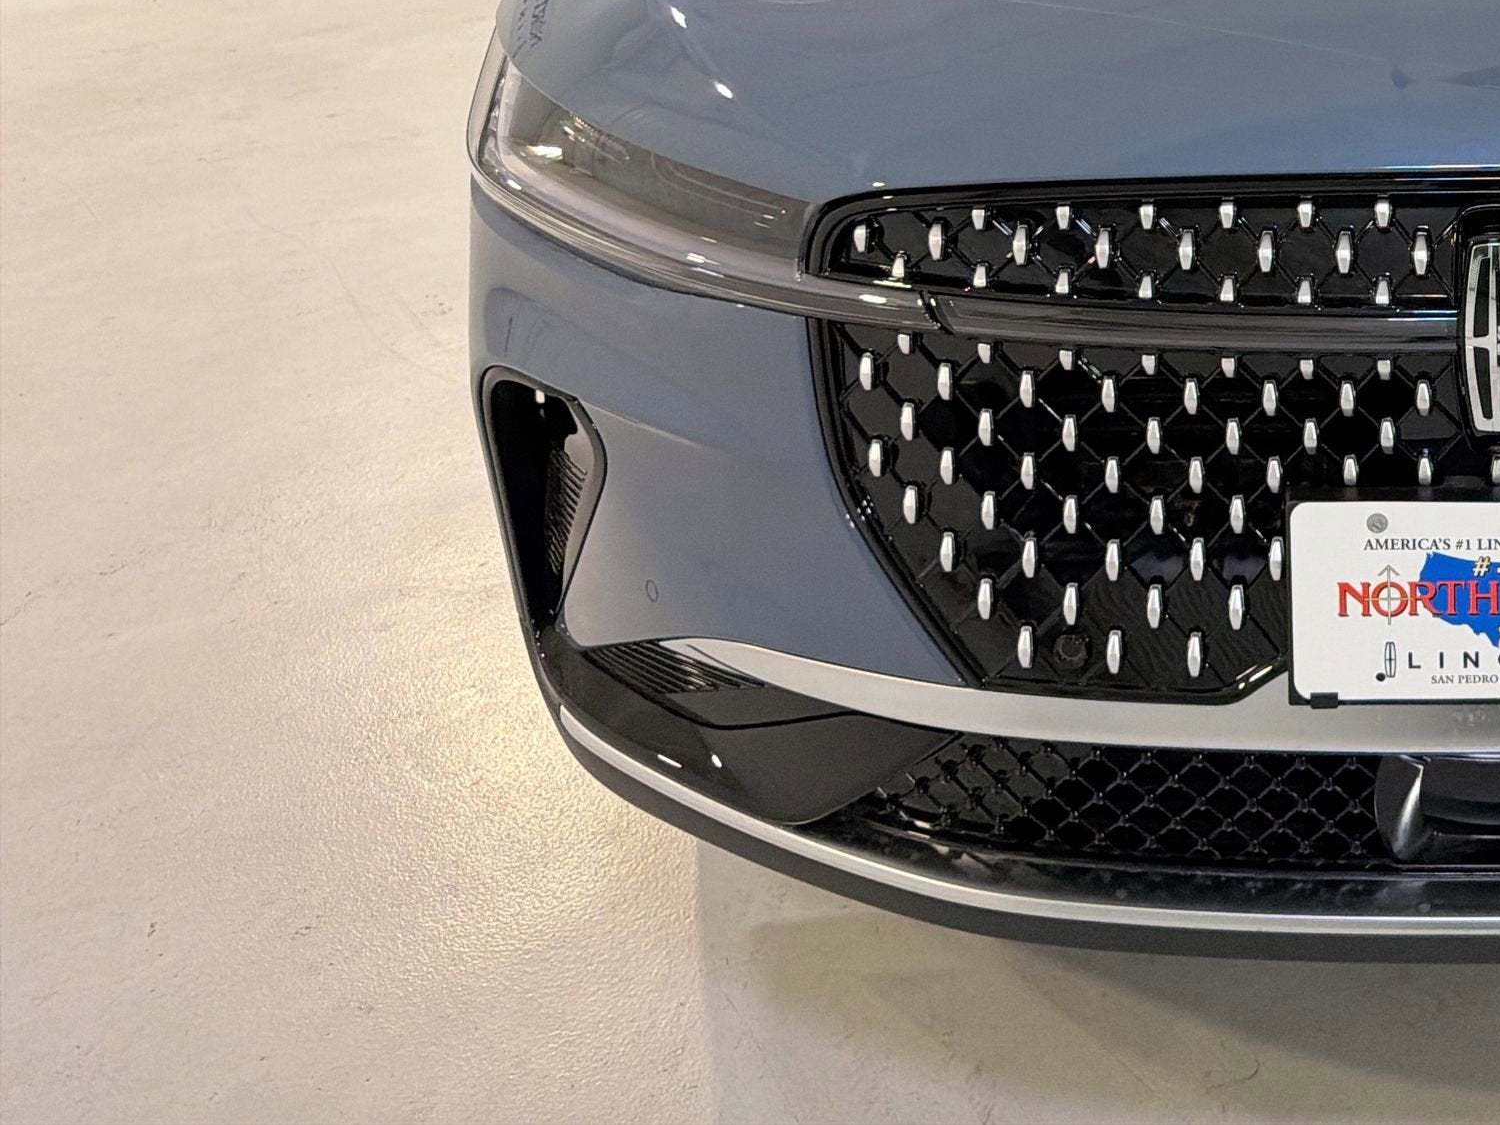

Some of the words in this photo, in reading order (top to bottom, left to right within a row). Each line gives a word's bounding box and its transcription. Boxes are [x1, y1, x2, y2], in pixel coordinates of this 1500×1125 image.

[1363, 538, 1451, 551] AMERICA'S
[1455, 538, 1472, 550] #1
[1336, 580, 1500, 618] NORTH
[1430, 675, 1454, 685] SAN
[1458, 674, 1499, 685] PEDRO
